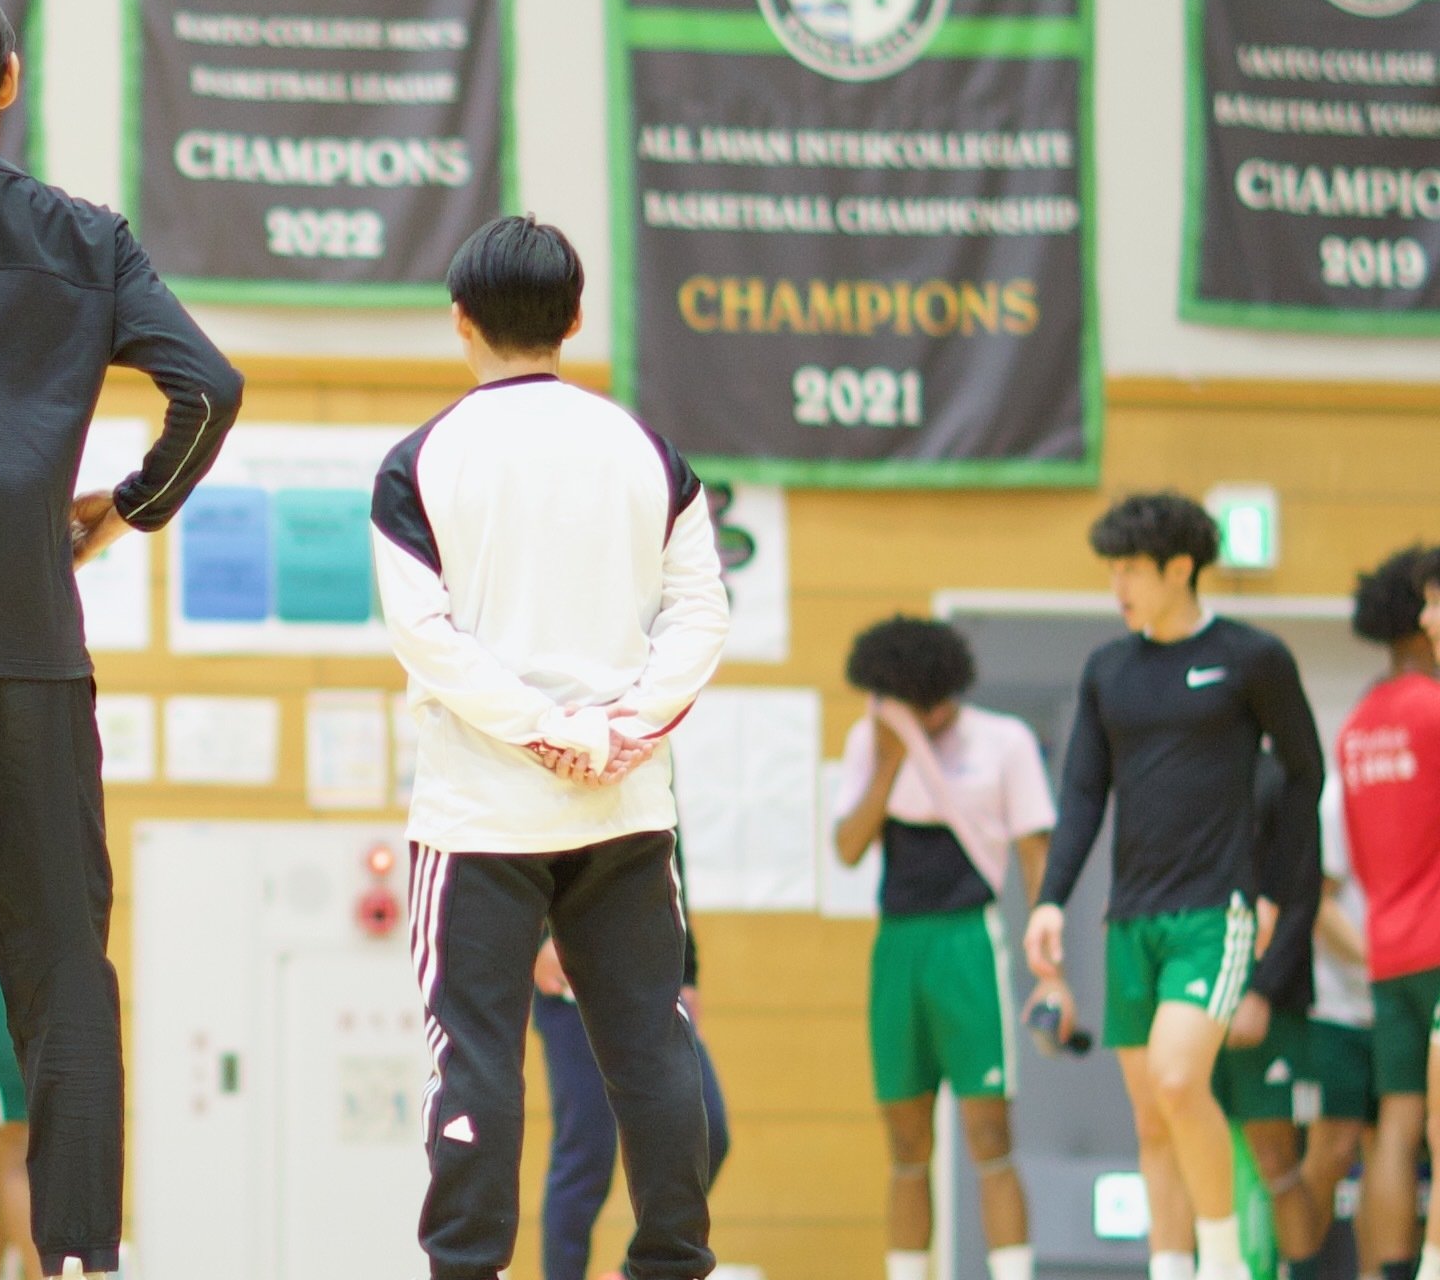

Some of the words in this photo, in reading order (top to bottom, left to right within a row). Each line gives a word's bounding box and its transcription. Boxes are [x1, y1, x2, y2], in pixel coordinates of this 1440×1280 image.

[174, 130, 473, 188] CHAMPIONS
[265, 206, 387, 259] 2022
[1320, 233, 1429, 291] 2019
[678, 274, 1041, 337] CHAMPIONS
[791, 365, 922, 427] 2021
